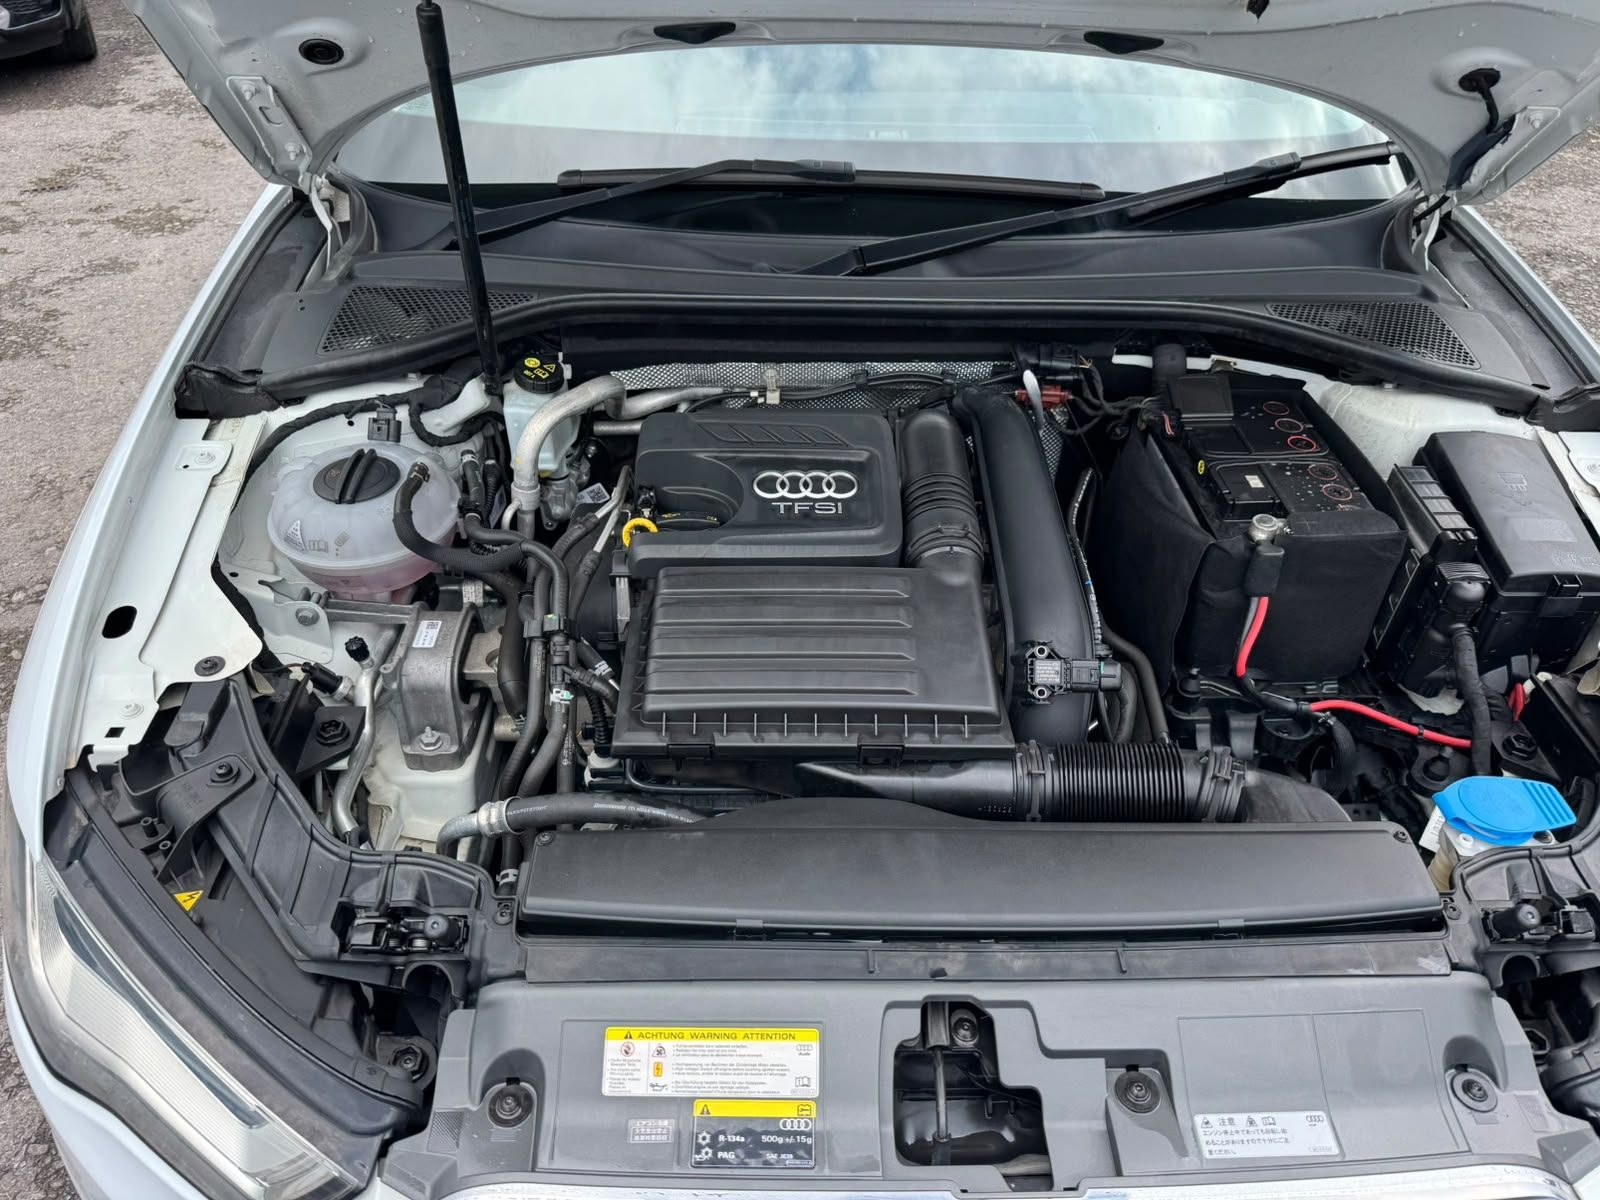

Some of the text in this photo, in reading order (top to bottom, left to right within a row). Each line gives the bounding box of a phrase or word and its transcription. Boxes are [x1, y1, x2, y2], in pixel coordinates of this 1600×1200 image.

[771, 502, 843, 514] TFSI
[637, 1031, 796, 1041] ACHTUNG WARNING ATTENTION
[1218, 1116, 1237, 1126] 注意
[718, 1134, 746, 1142] R-134a
[761, 1134, 784, 1144] 500g
[797, 1135, 812, 1145] 15g
[717, 1151, 736, 1159] PAG
